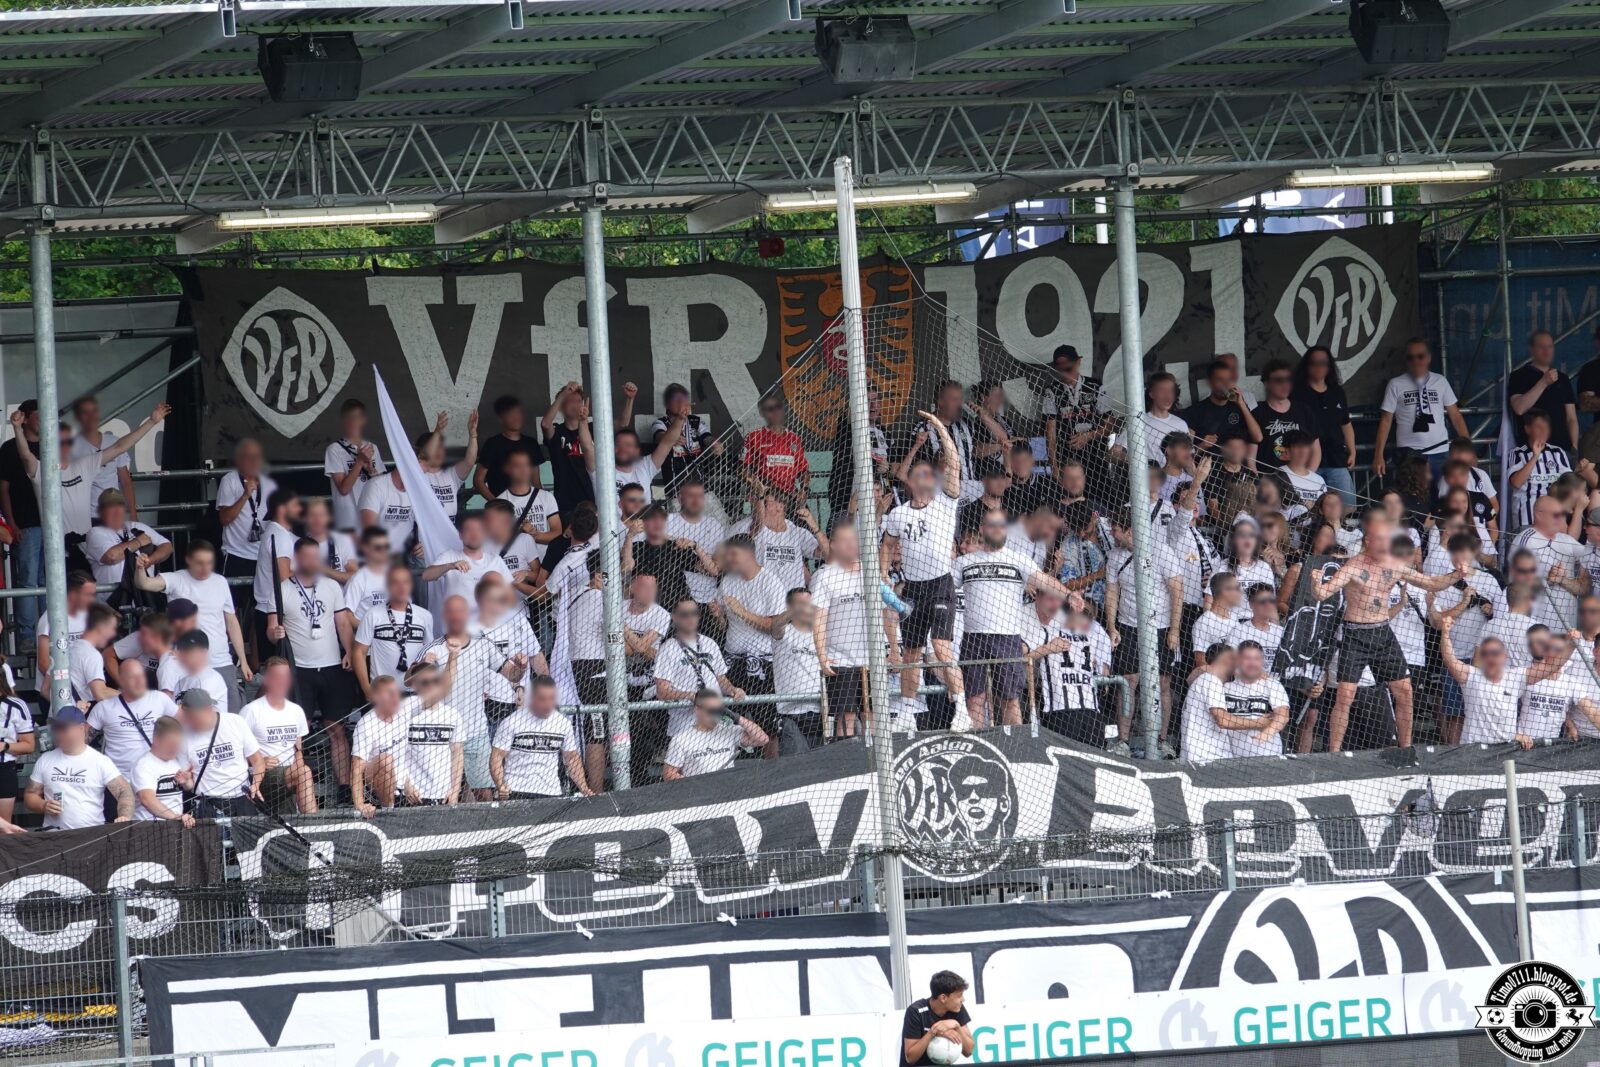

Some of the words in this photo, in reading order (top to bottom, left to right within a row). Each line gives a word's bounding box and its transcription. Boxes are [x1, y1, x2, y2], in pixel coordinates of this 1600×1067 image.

[366, 270, 772, 450] VfR
[923, 239, 1248, 408] 1921
[267, 727, 283, 736] WIR
[214, 744, 233, 755] SIND
[51, 774, 86, 784] classics
[1233, 997, 1393, 1047] GEIGER
[701, 1036, 867, 1067] GEIGER
[972, 1016, 1134, 1064] GEIGER
